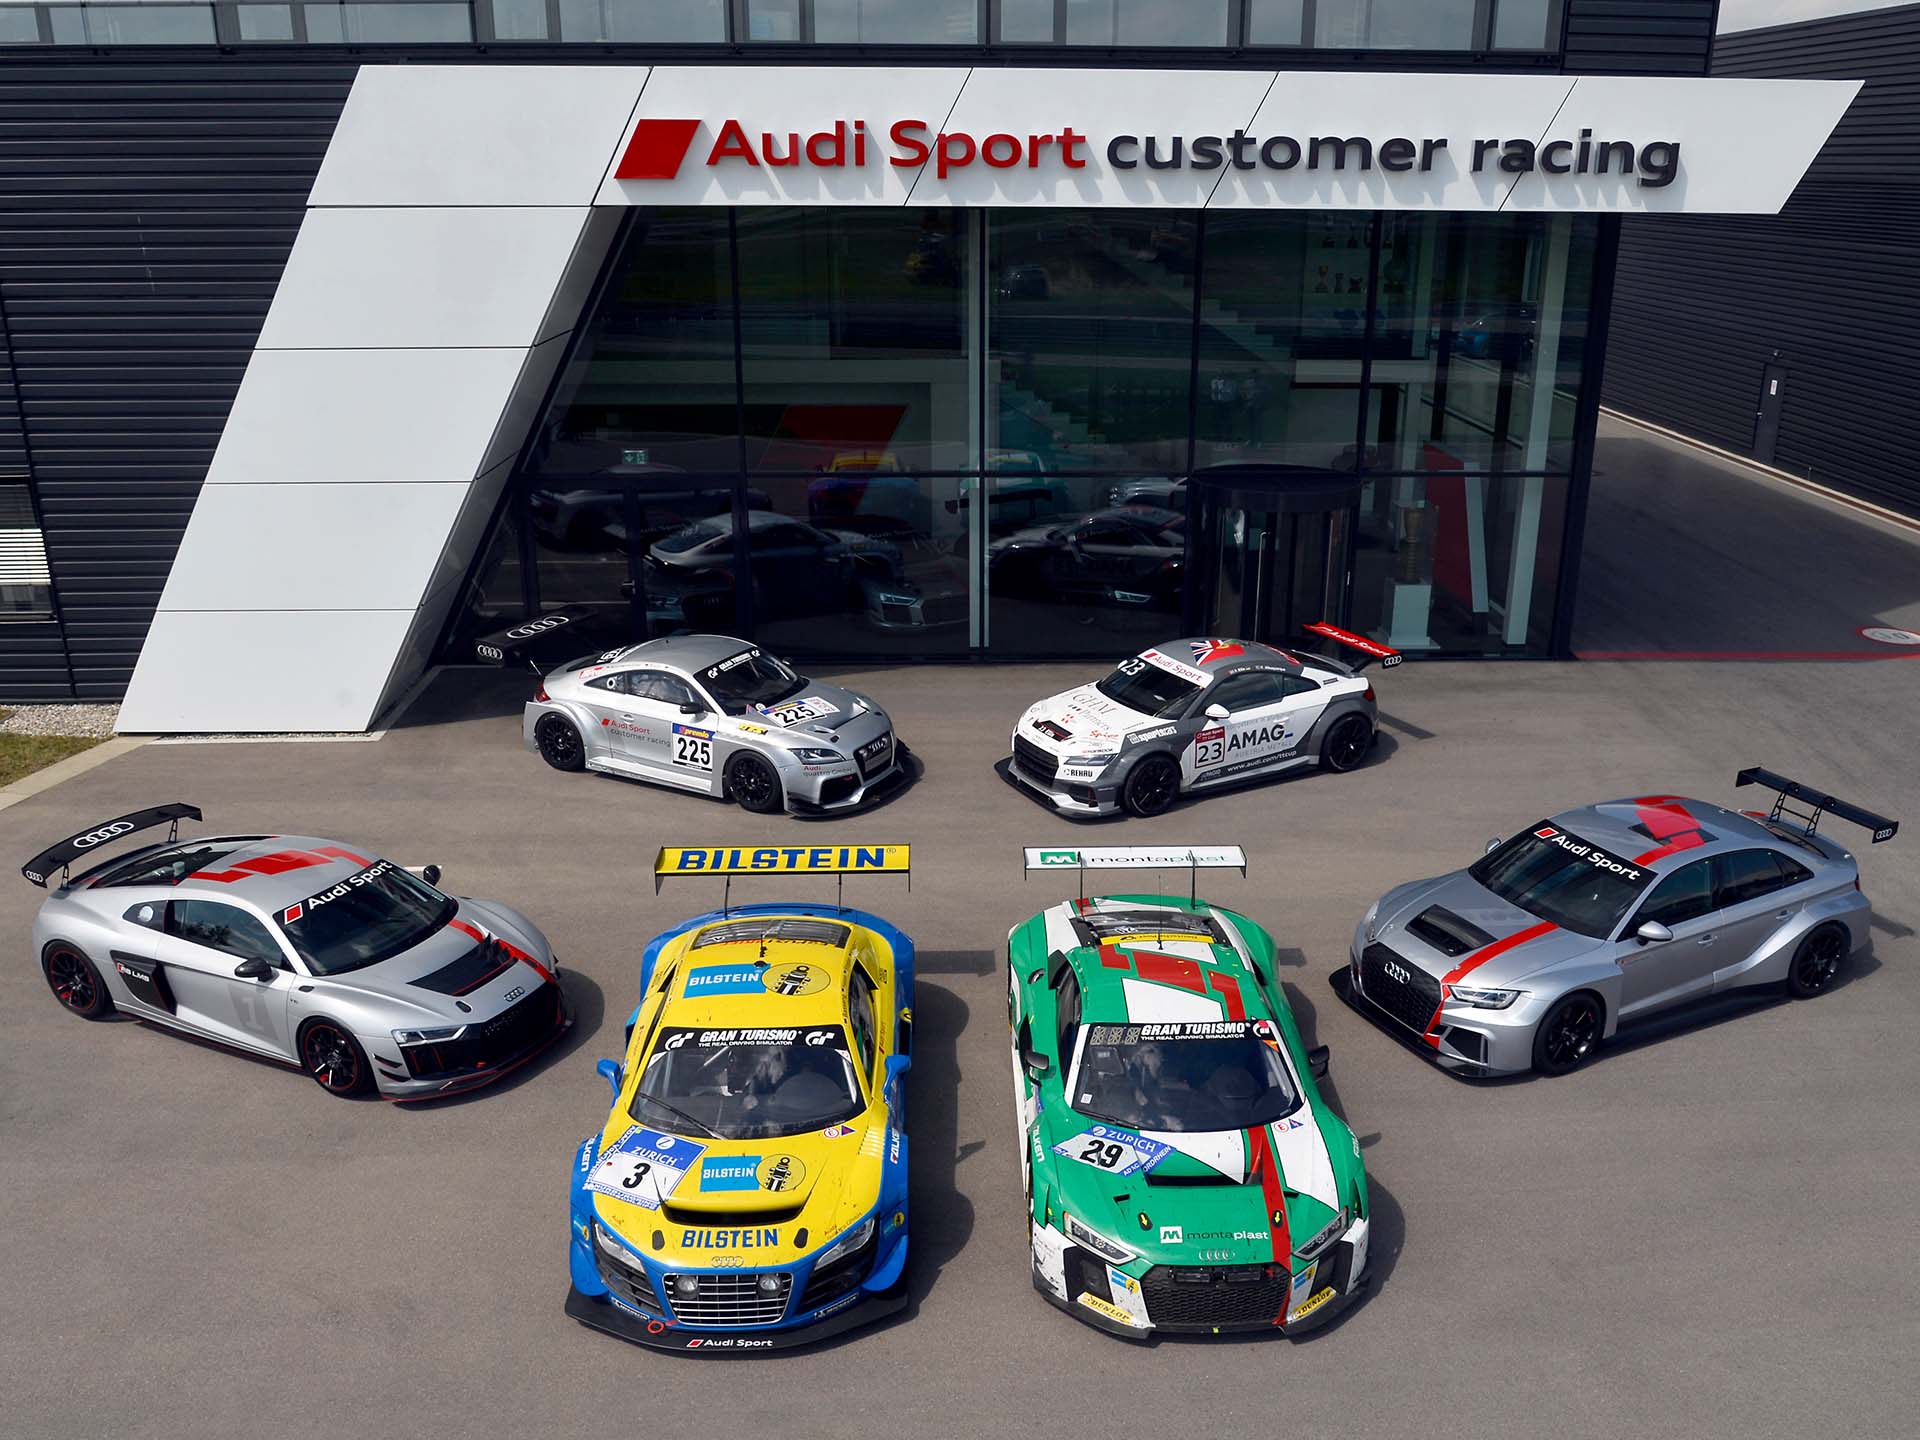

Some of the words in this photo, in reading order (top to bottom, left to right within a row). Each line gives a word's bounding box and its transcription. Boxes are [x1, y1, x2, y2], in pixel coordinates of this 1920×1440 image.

[706, 119, 866, 168] Audi
[889, 119, 1087, 180] Sport
[1106, 128, 1448, 172] customer
[1471, 128, 1681, 189] racing
[1121, 659, 1146, 676] 23
[1153, 656, 1174, 671] Audi
[1174, 664, 1203, 682] Sport
[775, 706, 815, 724] 225
[610, 720, 628, 730] Audi
[629, 724, 651, 735] Sport
[685, 729, 709, 739] premio
[610, 728, 645, 741] customer
[647, 737, 671, 748] racing
[1227, 724, 1285, 752] AMAG
[678, 737, 711, 765] 225
[1198, 742, 1222, 763] 23
[1071, 769, 1093, 777] REHAU
[677, 848, 885, 870] BILSTEIN
[1552, 835, 1591, 857] Audi
[1587, 852, 1641, 880] Sport
[308, 883, 352, 910] Audi
[349, 861, 393, 886] Sport
[132, 972, 150, 982] LMS
[689, 973, 759, 987] BILSTEIN
[699, 1030, 739, 1042] GRAN
[740, 1029, 797, 1041] TURISMO
[1141, 1024, 1182, 1036] GRAN
[1185, 1022, 1245, 1035] TURISMO
[1107, 1131, 1157, 1152] ZURICH
[631, 1146, 678, 1166] ZURICH
[1080, 1139, 1124, 1168] 29
[622, 1162, 651, 1189] 3
[703, 1167, 754, 1178] BILSTEIN
[681, 1229, 779, 1248] BILSTEIN
[1187, 1230, 1269, 1241] montaplast
[1091, 1300, 1131, 1320] DUNLOP
[1301, 1290, 1332, 1313] DUNLOP
[704, 1339, 734, 1347] Audi
[736, 1339, 774, 1348] Sport
